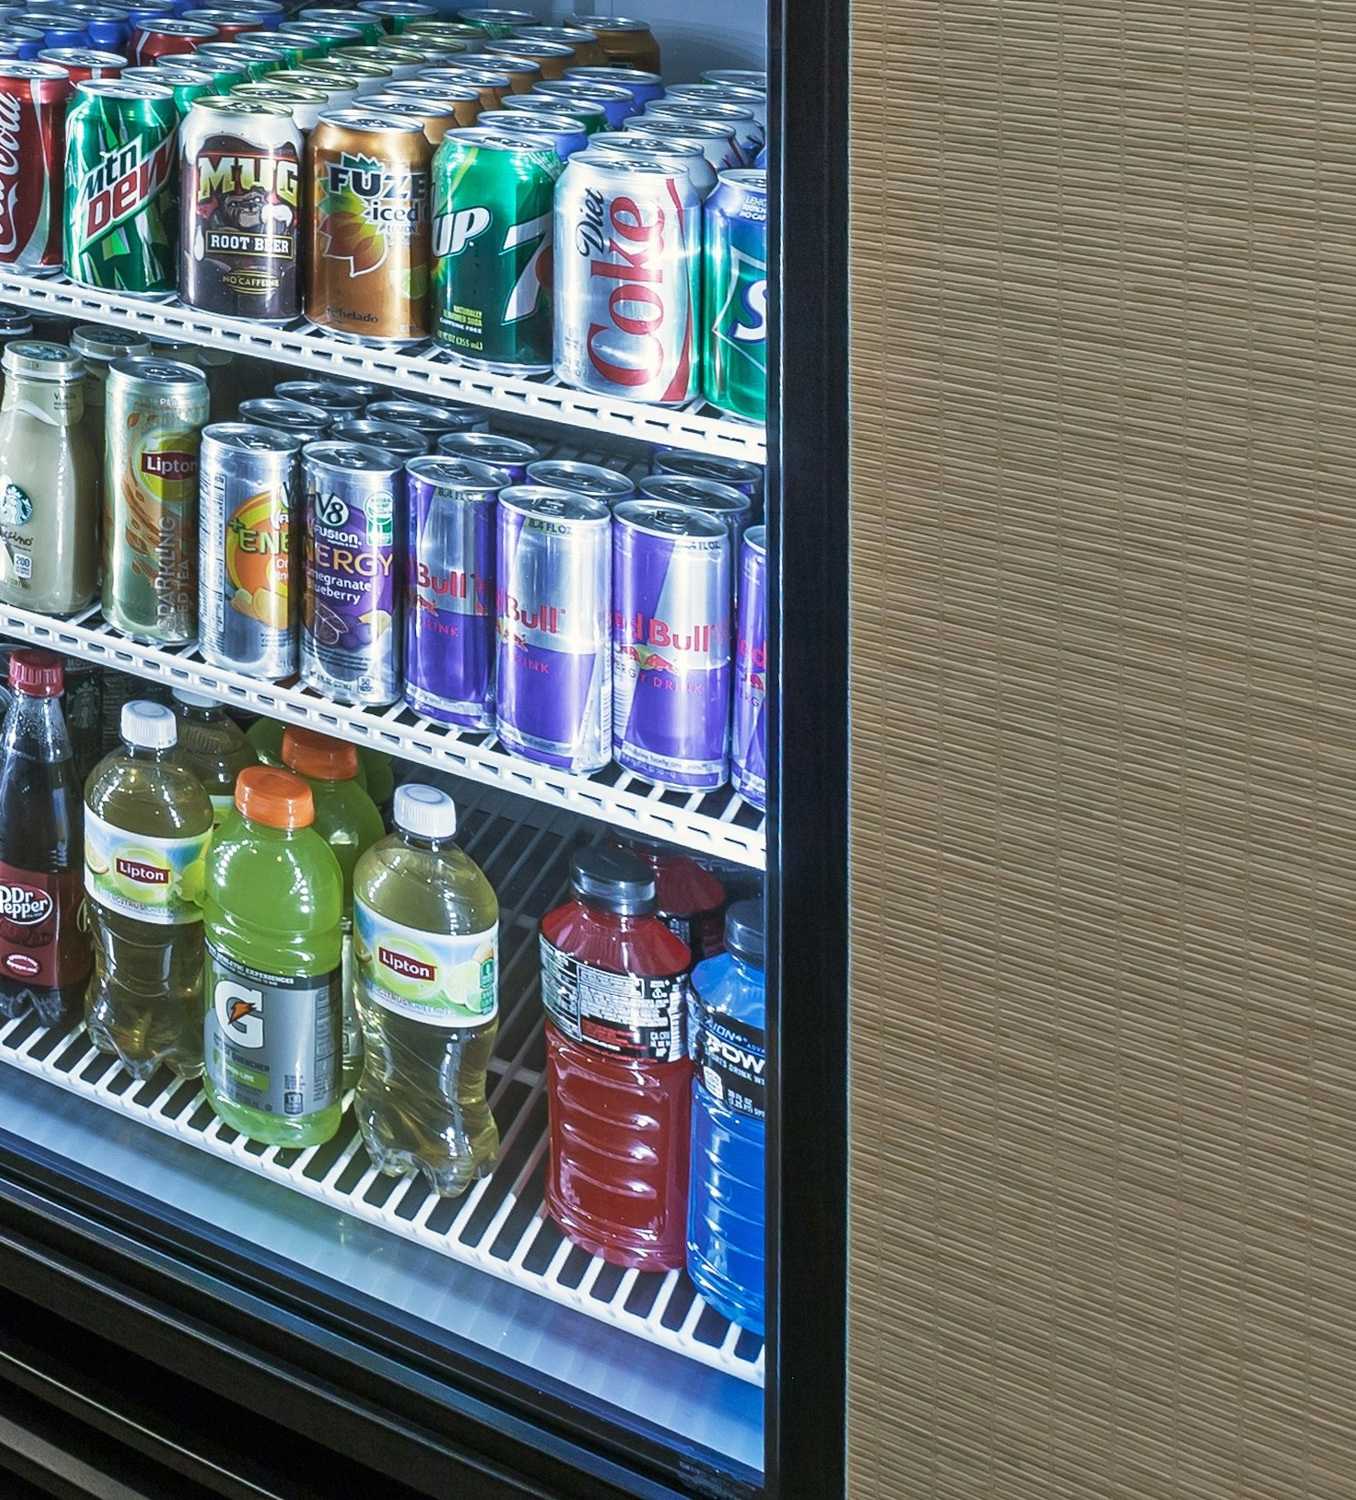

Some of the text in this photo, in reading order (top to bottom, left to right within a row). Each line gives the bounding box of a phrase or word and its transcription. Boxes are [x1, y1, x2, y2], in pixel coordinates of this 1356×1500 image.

[198, 156, 298, 208] MUG
[329, 166, 427, 200] FUZE
[372, 201, 420, 222] iced
[575, 187, 605, 257] Diet
[211, 234, 250, 250] ROOT
[432, 206, 491, 257] UP
[222, 275, 237, 284] NO
[502, 208, 554, 322] 7
[587, 196, 665, 386] Coke
[147, 455, 197, 475] Lipton
[316, 491, 344, 525] V8
[528, 519, 545, 530] 8.4
[546, 523, 557, 533] FL
[154, 515, 176, 631] SPARKLING
[417, 562, 467, 599] Bull
[506, 594, 558, 634] Bull
[649, 618, 711, 653] Bull
[119, 861, 165, 881] Lipton
[11, 887, 34, 903] Dr
[382, 951, 430, 978] Lipton
[215, 980, 264, 1049] G
